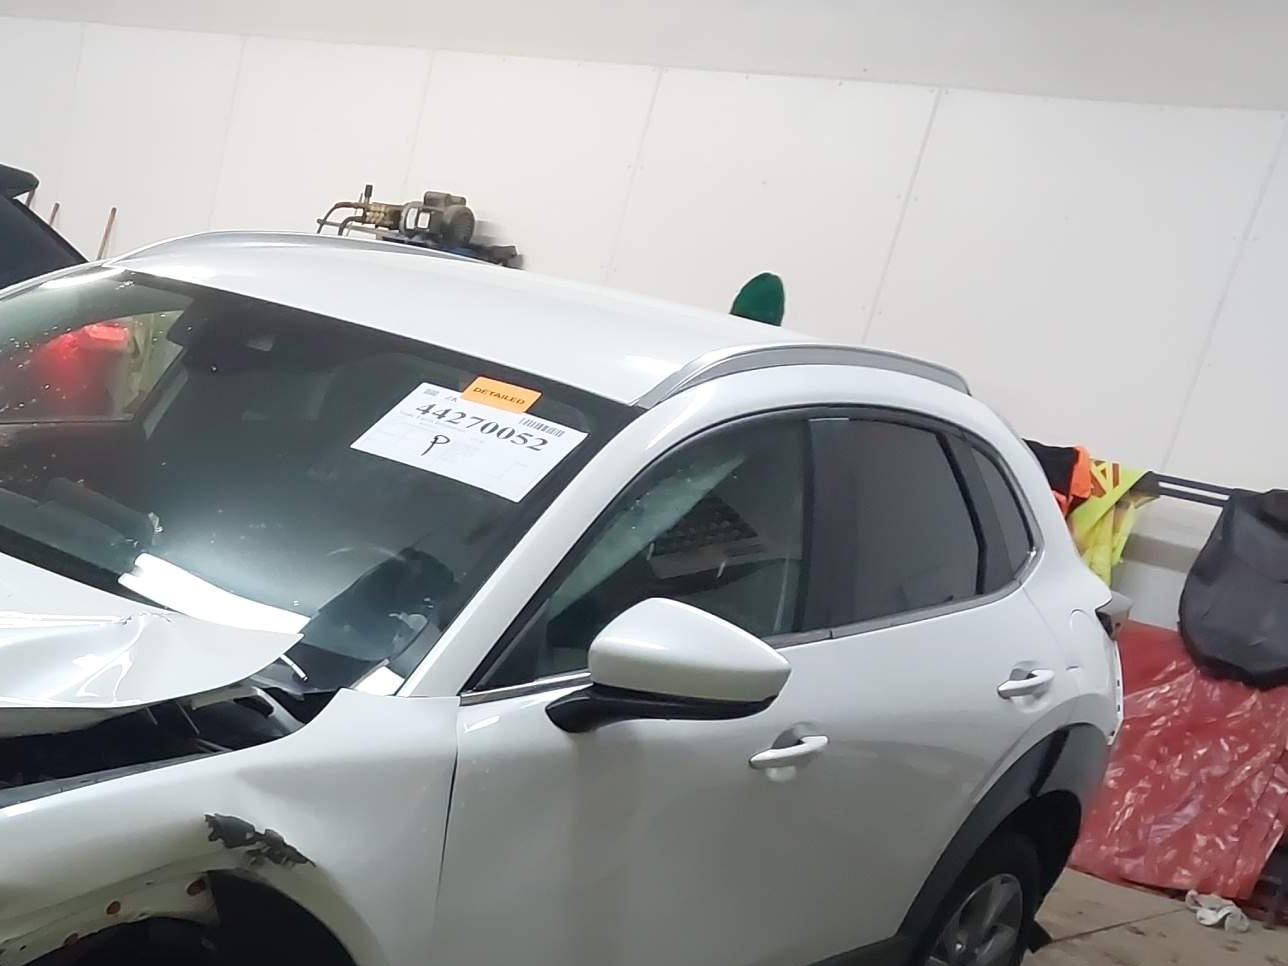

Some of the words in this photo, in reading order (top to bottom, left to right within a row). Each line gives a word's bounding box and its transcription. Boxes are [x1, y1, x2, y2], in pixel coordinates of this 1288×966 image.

[472, 387, 525, 405] DETAILED
[415, 403, 549, 452] 44270052
[420, 434, 451, 457] P
